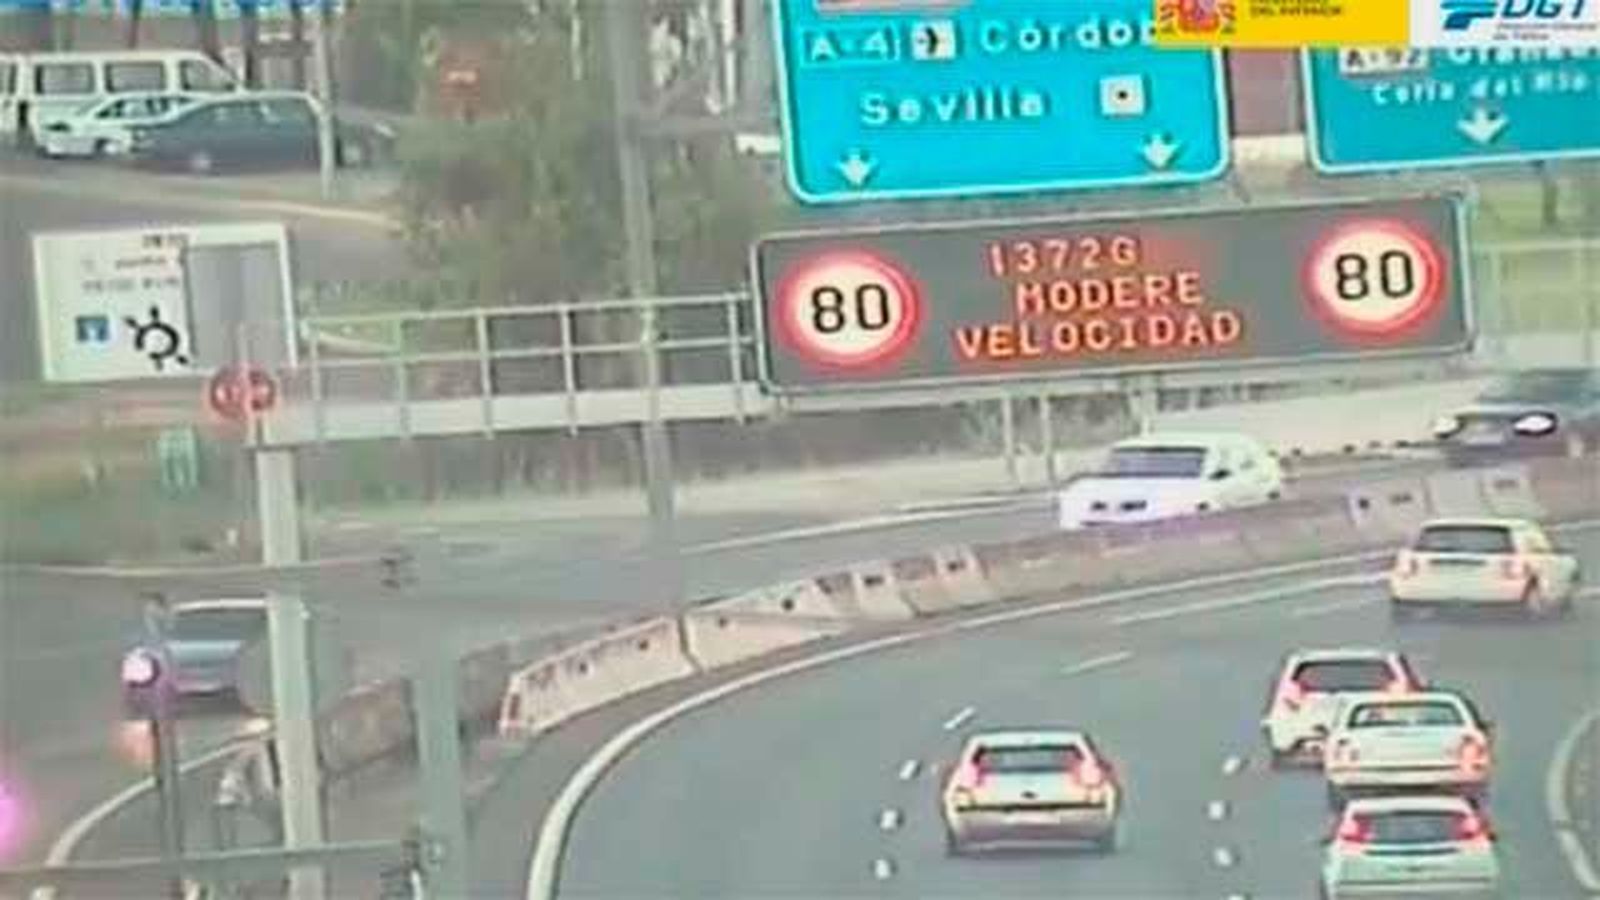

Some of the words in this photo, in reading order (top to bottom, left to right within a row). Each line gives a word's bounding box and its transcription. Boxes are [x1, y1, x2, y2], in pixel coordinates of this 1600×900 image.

[810, 32, 889, 61] A-4
[861, 87, 1045, 126] Sevilla
[1015, 271, 1203, 315] MODERE
[1334, 249, 1416, 301] 80
[810, 285, 891, 334] 80
[955, 311, 1241, 358] VELOCIDAD
